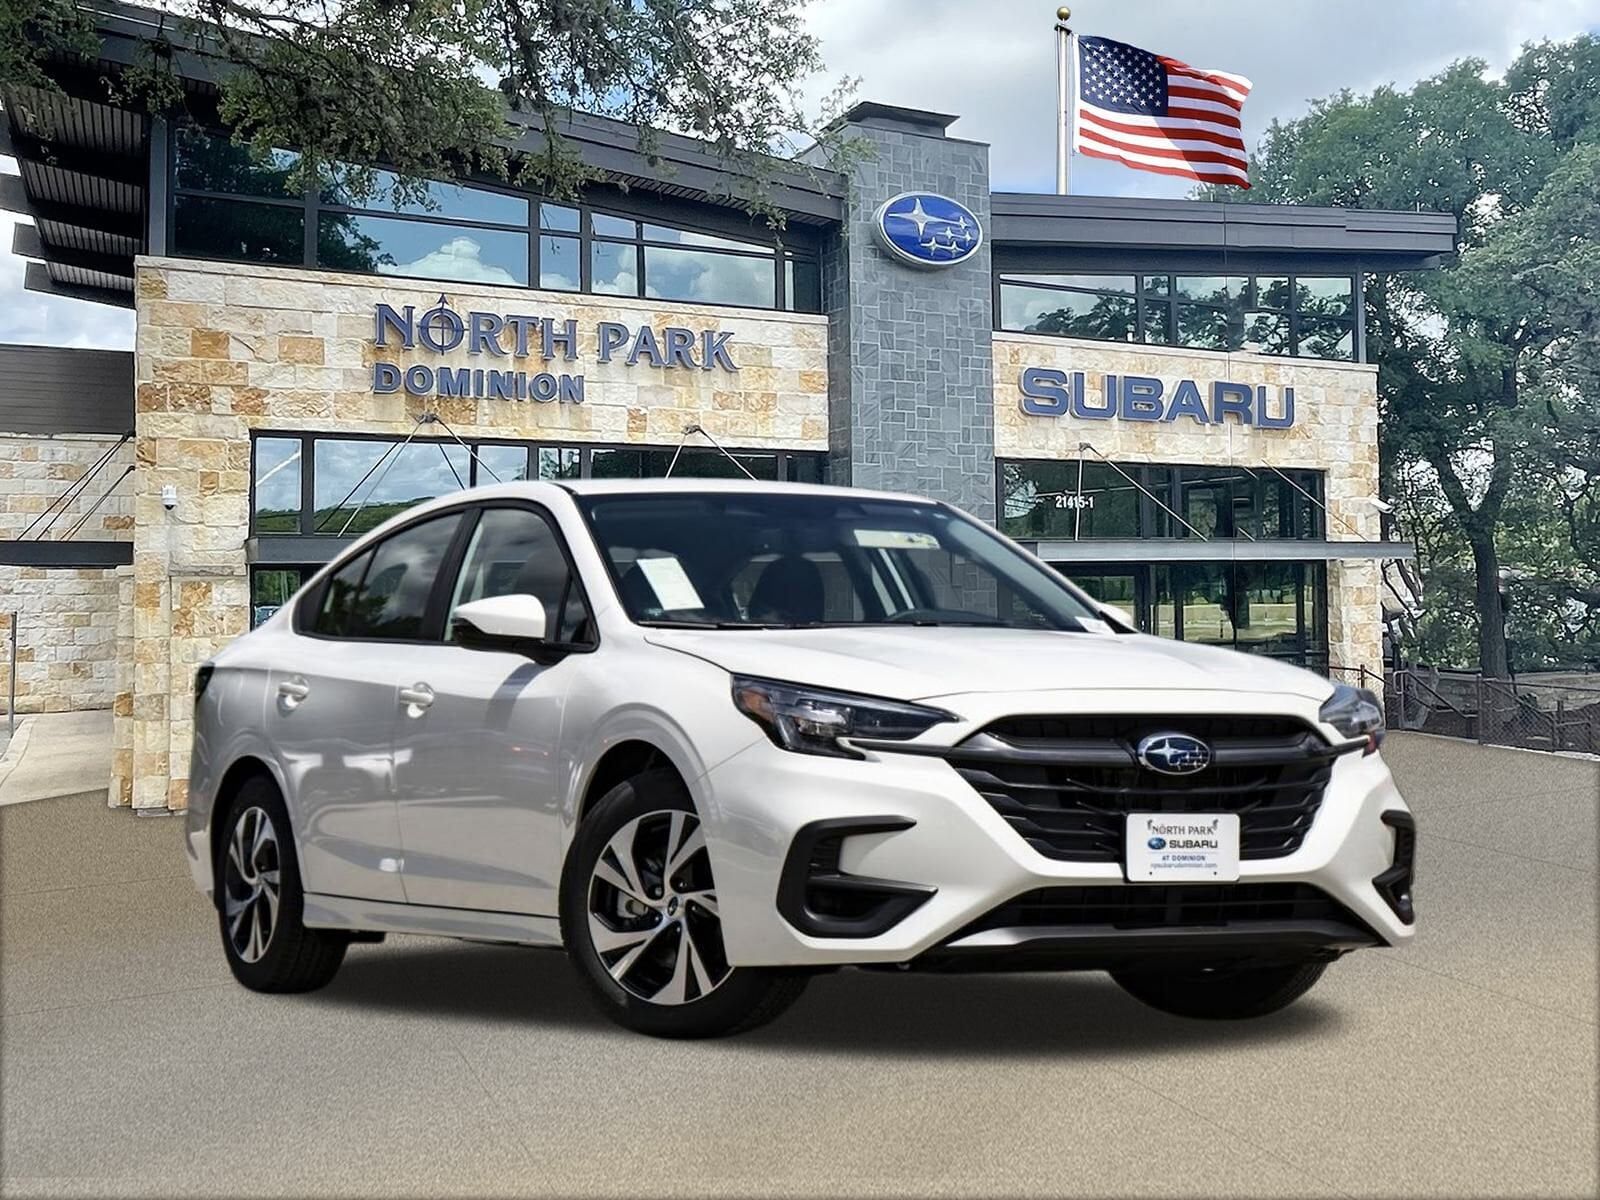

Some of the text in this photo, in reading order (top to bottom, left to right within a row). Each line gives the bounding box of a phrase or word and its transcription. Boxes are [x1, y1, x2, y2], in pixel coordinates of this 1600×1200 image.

[375, 293, 740, 371] NORTH PARK
[373, 362, 585, 404] DOMINION
[1018, 367, 1295, 430] SUBARU
[1152, 825, 1214, 835] NORTH PARK
[1169, 840, 1218, 849] SUBARU
